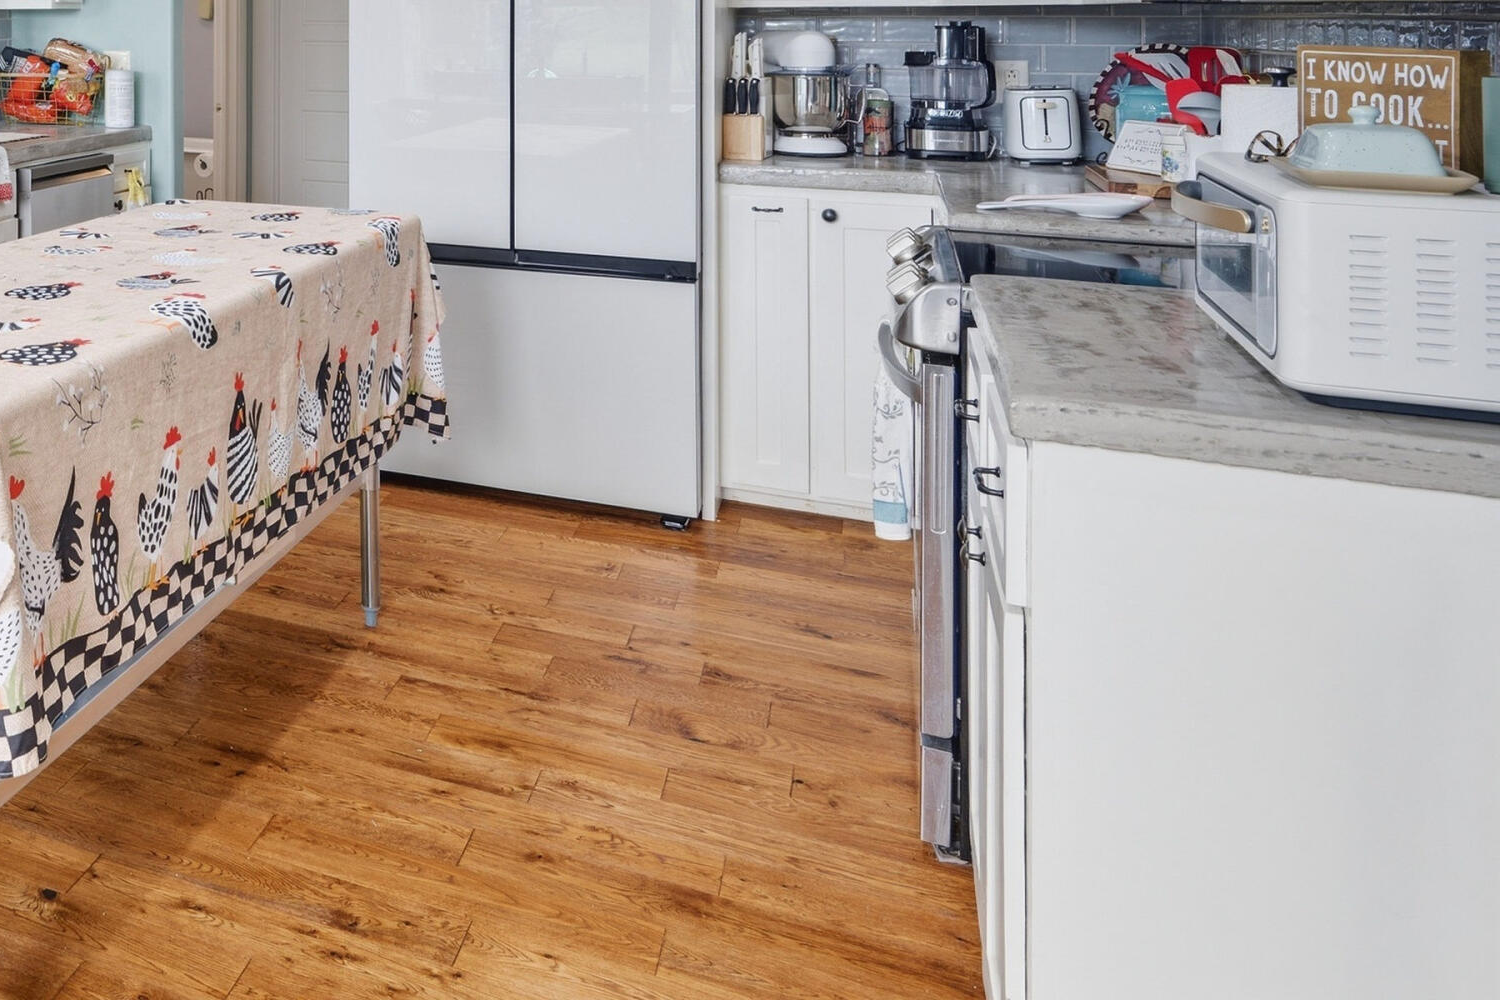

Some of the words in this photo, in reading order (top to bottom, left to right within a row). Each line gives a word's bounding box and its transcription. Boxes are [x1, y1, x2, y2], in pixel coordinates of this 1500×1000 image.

[1306, 58, 1317, 80] I
[1323, 59, 1387, 85] KNOW
[1394, 63, 1449, 90] HOW
[1306, 88, 1338, 120] TO
